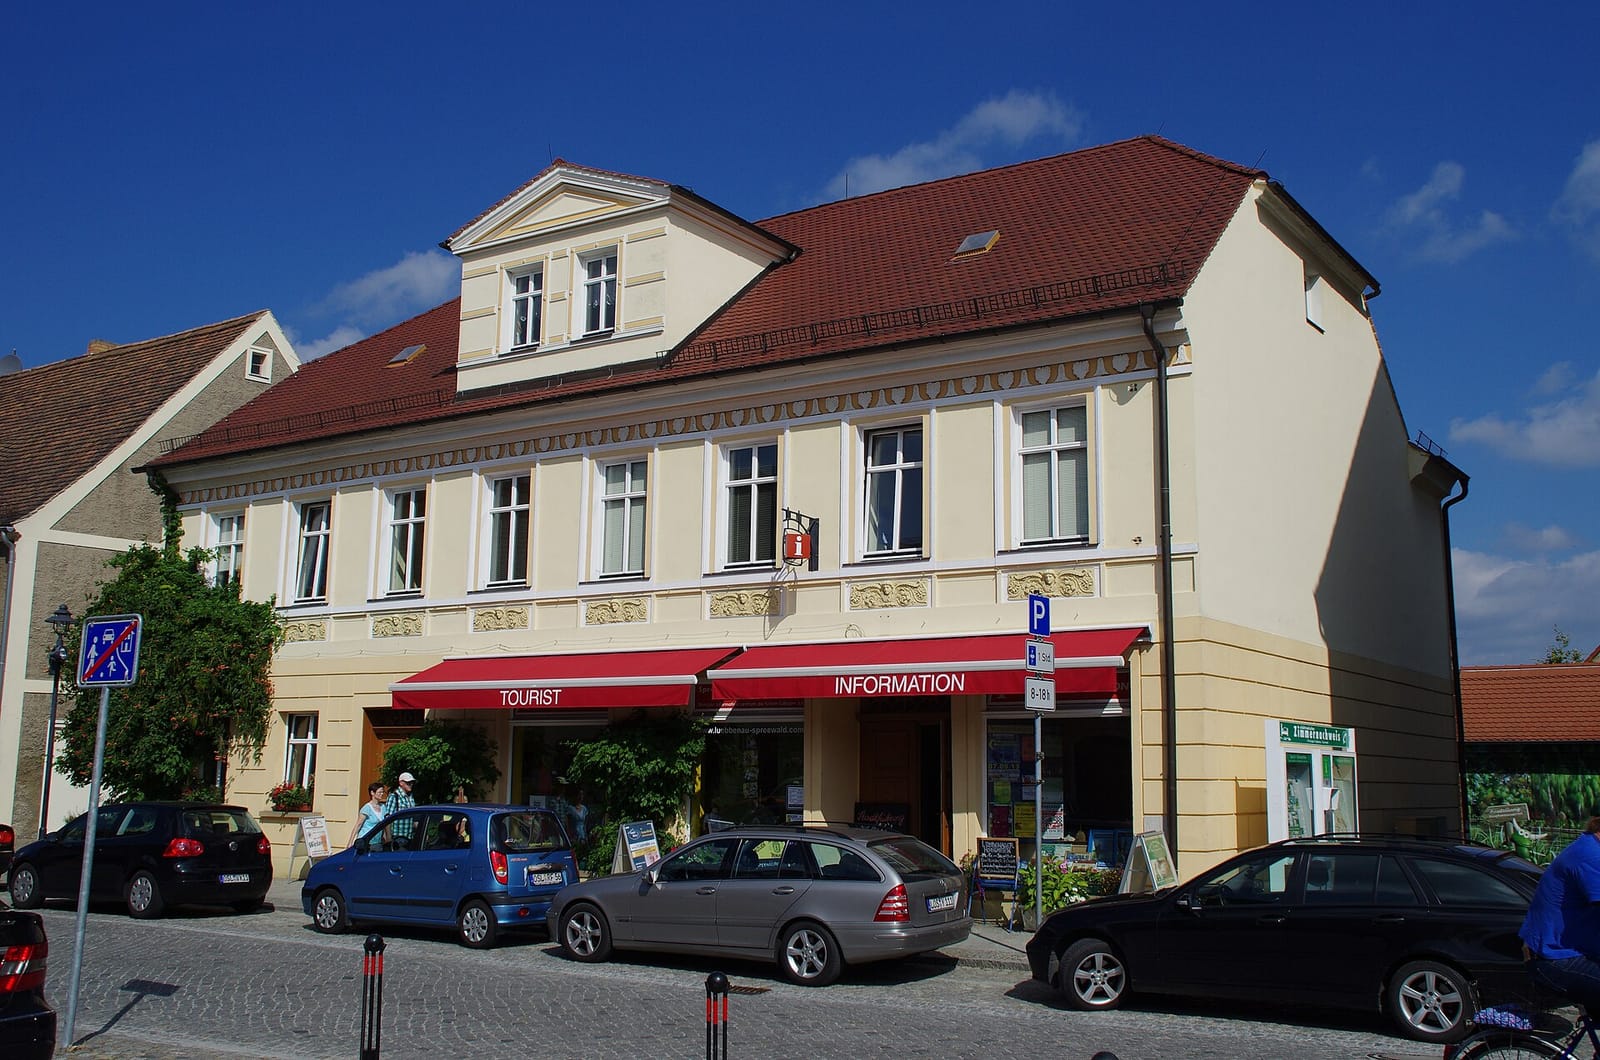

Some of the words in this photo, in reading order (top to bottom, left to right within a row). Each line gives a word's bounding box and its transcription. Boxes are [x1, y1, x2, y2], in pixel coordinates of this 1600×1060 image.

[794, 536, 803, 556] i
[1033, 599, 1046, 630] P
[835, 673, 965, 694] INFORMATION
[499, 688, 562, 706] TOURIST
